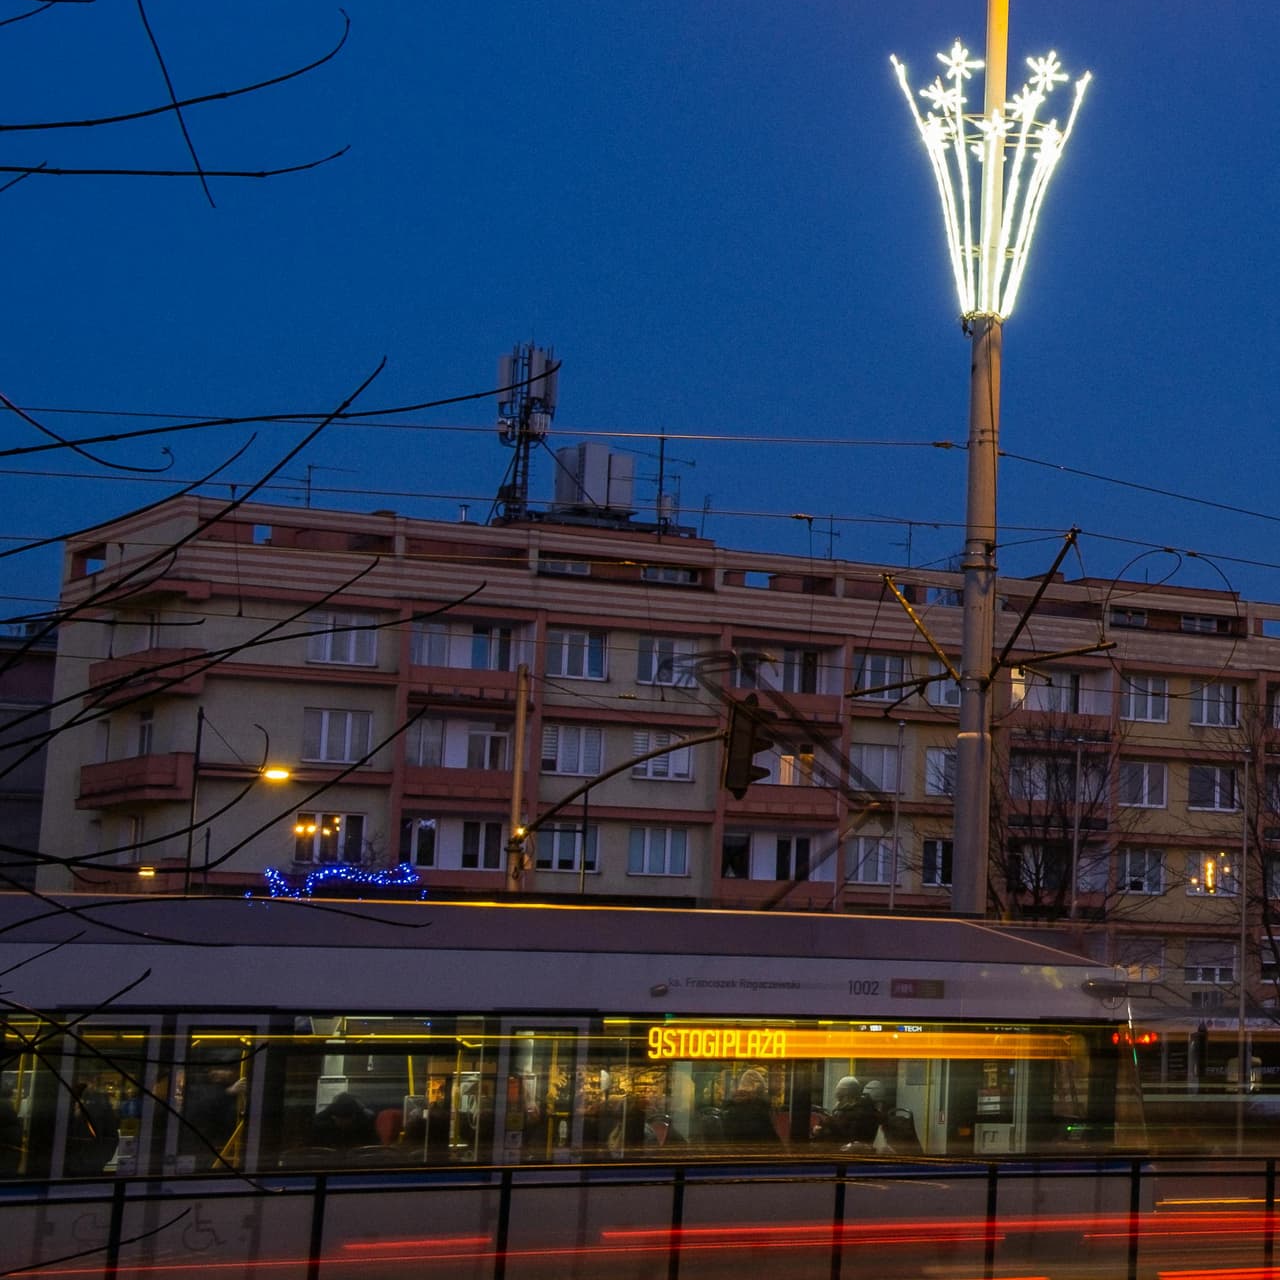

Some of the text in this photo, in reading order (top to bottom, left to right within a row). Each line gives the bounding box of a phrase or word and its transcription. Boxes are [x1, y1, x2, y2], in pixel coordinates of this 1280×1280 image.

[848, 979, 880, 996] 1002
[648, 1027, 662, 1059] 9
[663, 1029, 719, 1058] STOGI
